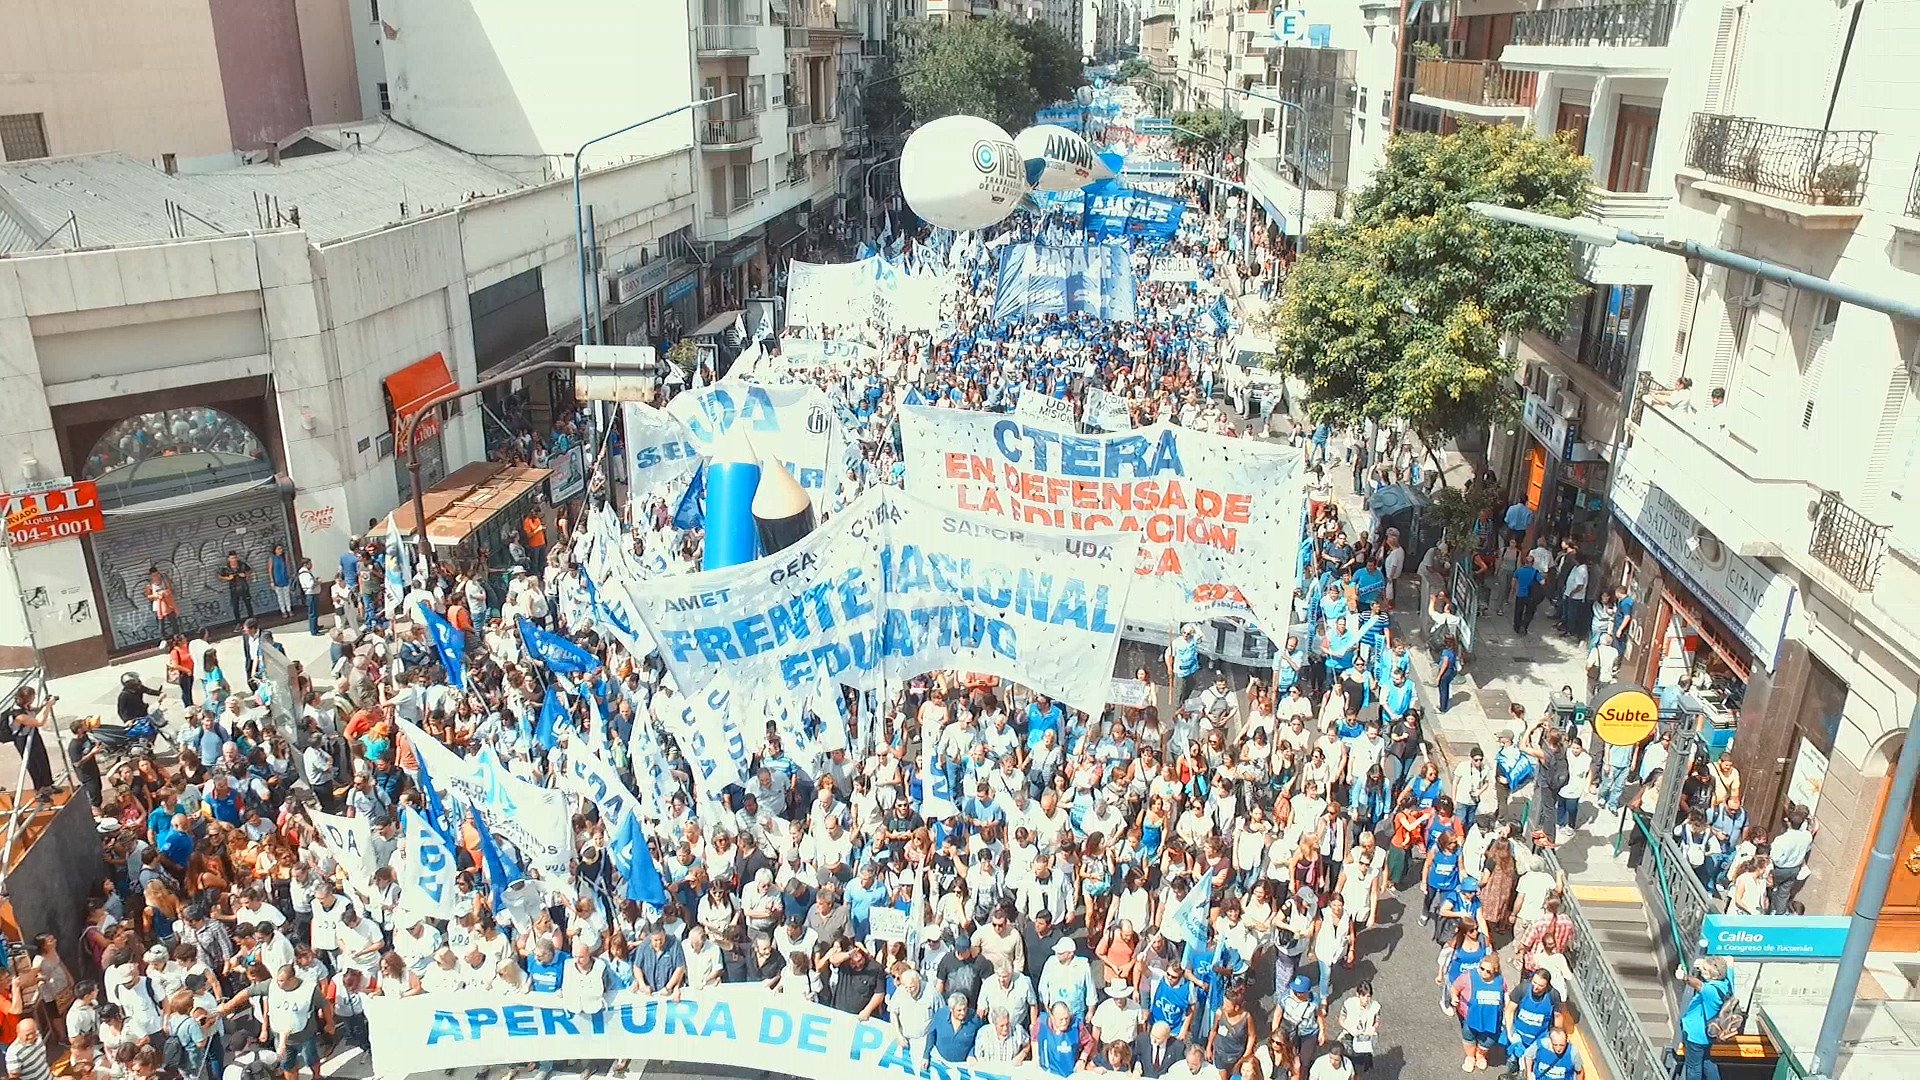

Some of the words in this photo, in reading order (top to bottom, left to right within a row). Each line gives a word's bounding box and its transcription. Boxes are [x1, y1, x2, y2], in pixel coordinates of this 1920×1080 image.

[1284, 16, 1296, 34] E
[993, 420, 1185, 478] CTERA
[944, 452, 997, 484] EN
[1004, 462, 1188, 512] DEFENSA
[1194, 487, 1253, 524] DE
[956, 484, 1006, 517] LA
[23, 515, 60, 526] ALQUILA
[1647, 505, 1694, 560] SATURNO
[1064, 538, 1114, 561] UDA
[664, 588, 731, 612] AMET
[660, 566, 875, 663] FRENTE
[1575, 712, 1586, 721] D
[1605, 708, 1650, 722] Subte
[1717, 931, 1764, 943] Callao
[1724, 944, 1762, 953] Congreso
[1763, 944, 1776, 952] de
[1777, 944, 1814, 953] Tucumán
[426, 999, 738, 1046] APERTURA
[757, 1006, 832, 1054] DE
